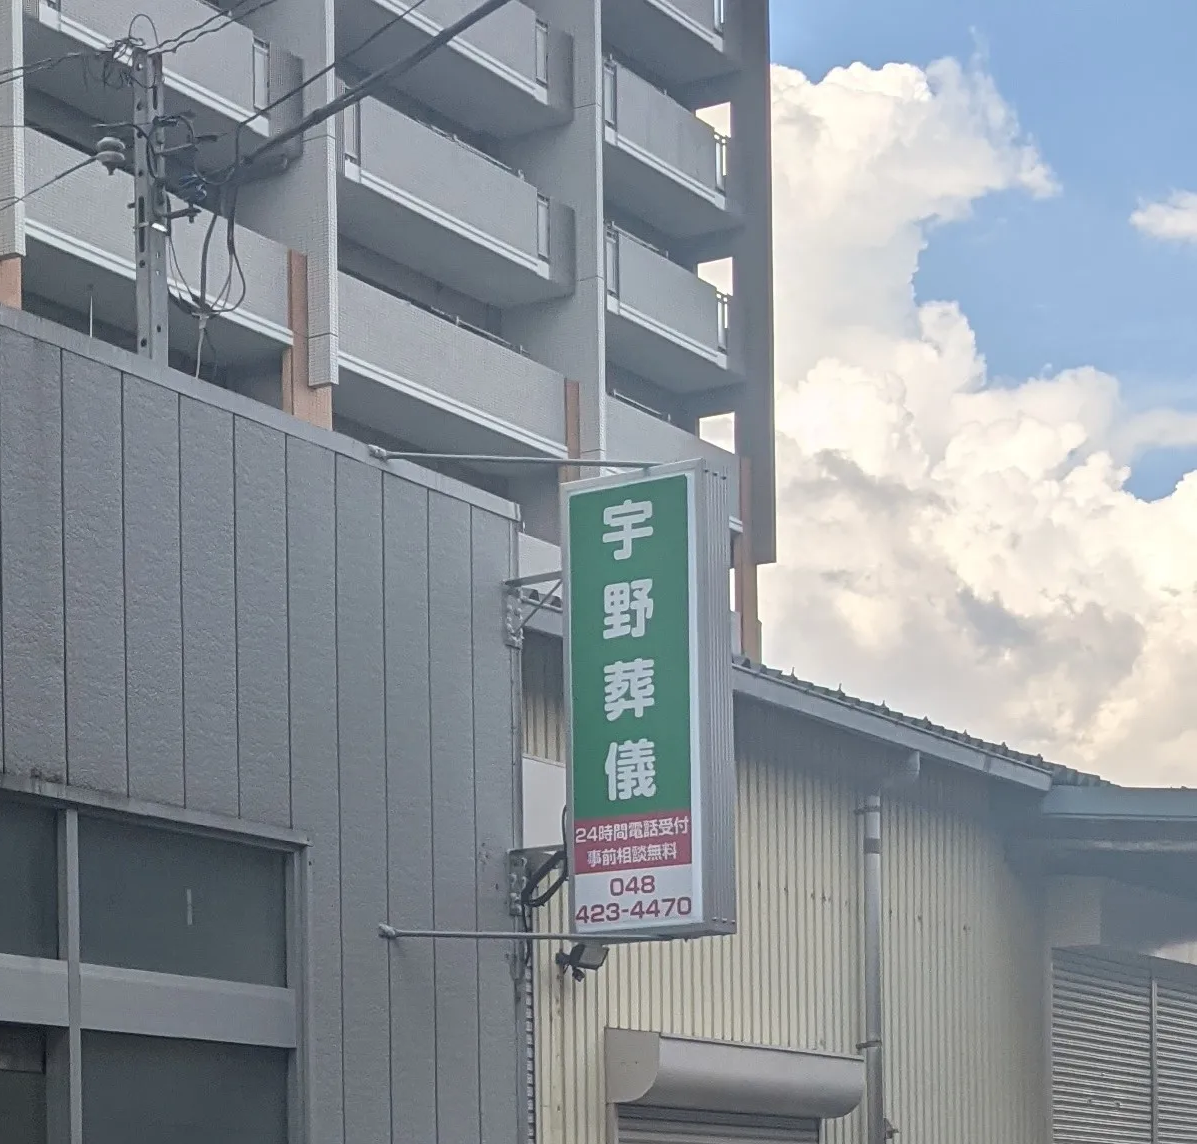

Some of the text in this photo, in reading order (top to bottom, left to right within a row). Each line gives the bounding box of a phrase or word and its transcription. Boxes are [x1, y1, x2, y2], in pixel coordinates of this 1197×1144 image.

[602, 499, 657, 801] 宇野葬儀
[575, 816, 689, 843] 24時間電話受付
[587, 842, 677, 867] 事前相談無料
[609, 875, 656, 897] 048
[575, 896, 692, 924] 423-4470
